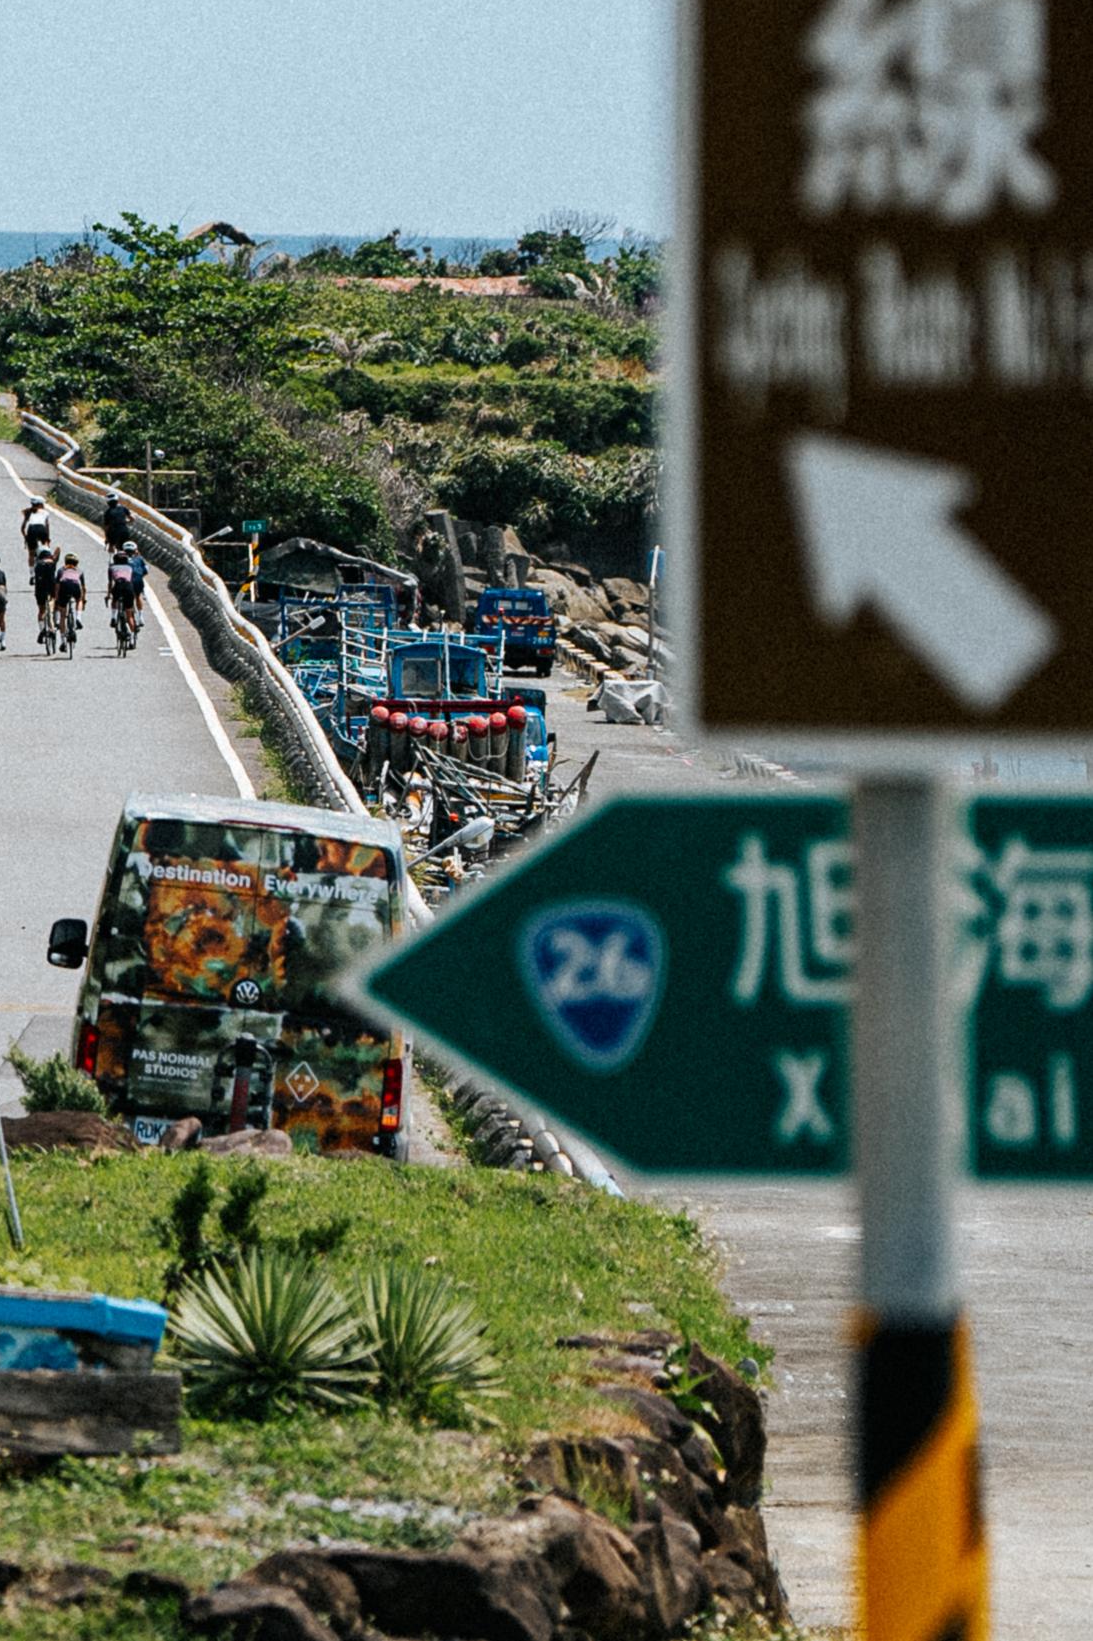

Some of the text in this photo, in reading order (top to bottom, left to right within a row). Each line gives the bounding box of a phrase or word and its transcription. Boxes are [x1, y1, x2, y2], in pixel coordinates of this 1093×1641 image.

[140, 862, 379, 904] Destination Everywhere
[132, 1048, 210, 1068] PAS NORMAL
